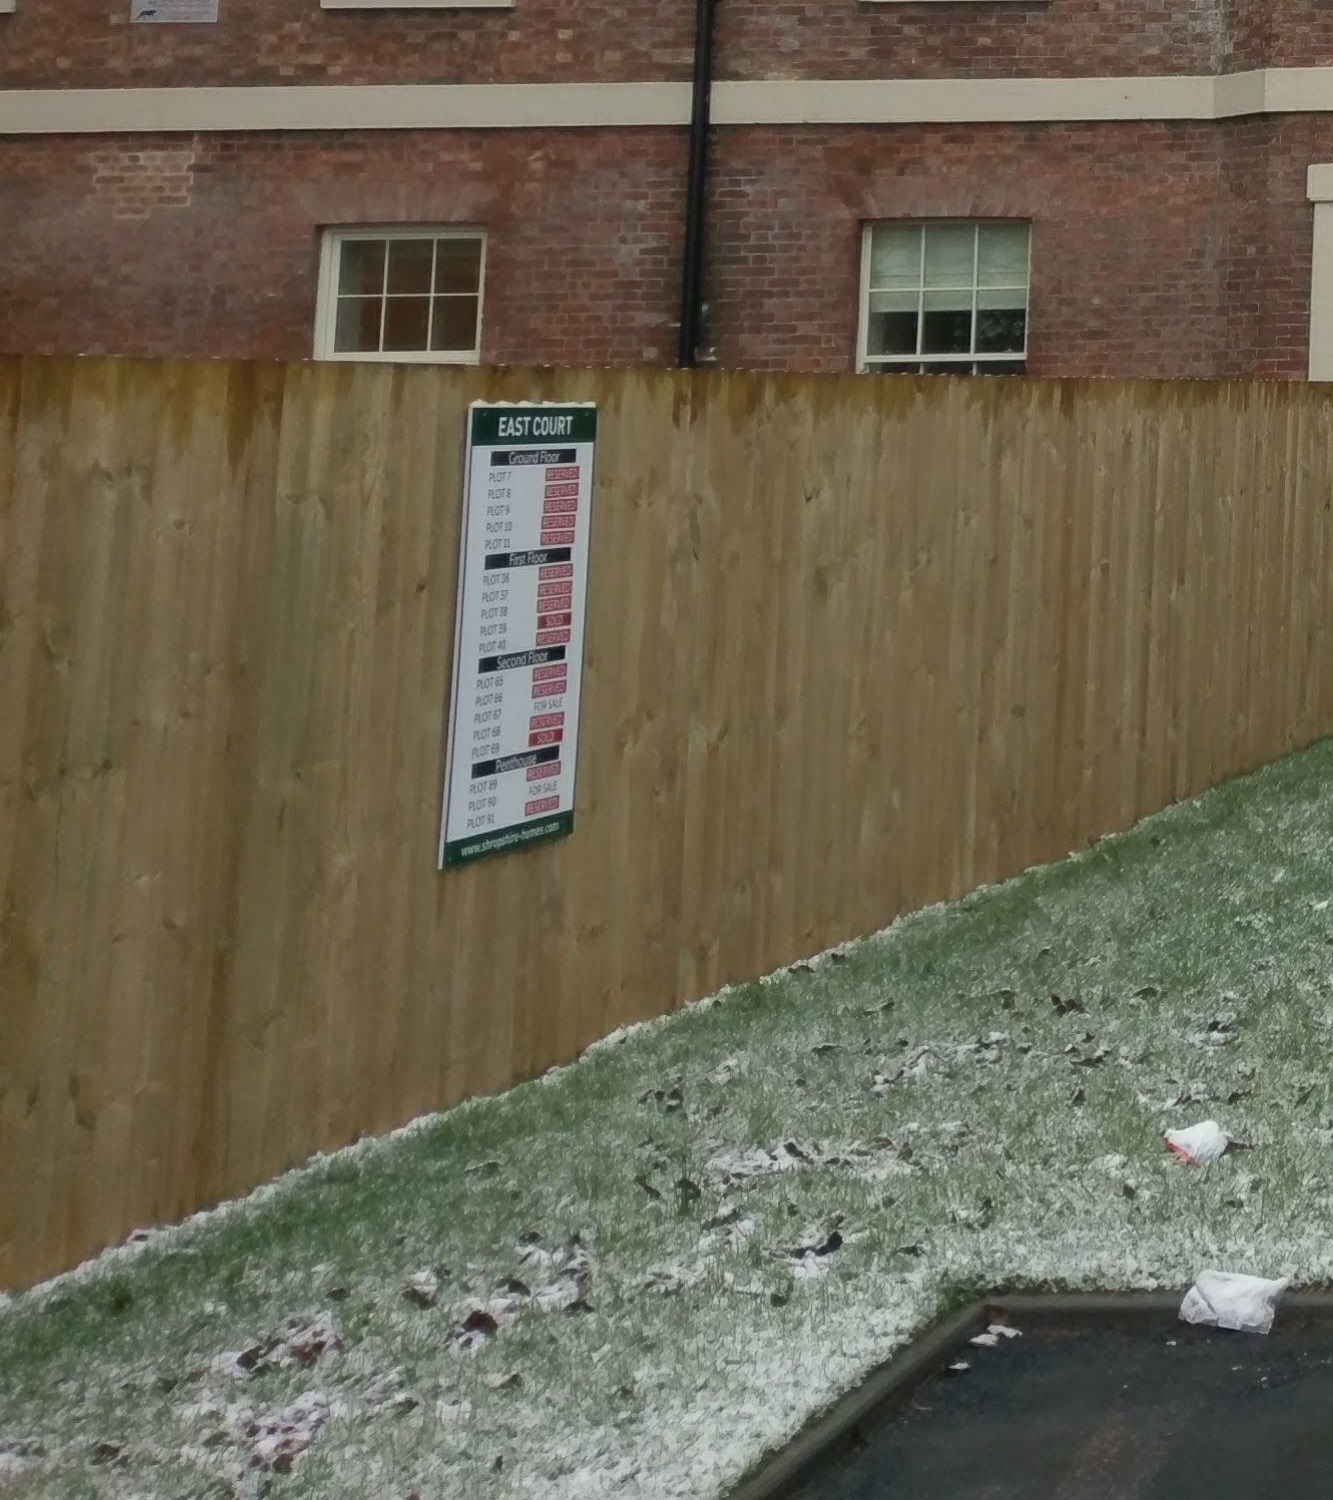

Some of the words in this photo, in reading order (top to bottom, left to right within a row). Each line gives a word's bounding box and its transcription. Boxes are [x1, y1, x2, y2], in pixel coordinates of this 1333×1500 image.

[498, 416, 532, 437] EAST
[532, 415, 574, 436] COURT
[508, 450, 540, 465] Ground
[540, 450, 561, 463] Floor
[488, 472, 506, 483] PLOT
[487, 488, 506, 500] PLOT
[486, 505, 505, 516] PLOT
[485, 522, 504, 533] PLOT
[484, 539, 503, 550] PLOT
[509, 552, 527, 567] First
[527, 551, 549, 564] Floor
[482, 574, 501, 586] PLOT
[481, 591, 501, 603] PLOT
[480, 607, 499, 620] PLOT
[480, 624, 498, 636] PLOT
[545, 614, 564, 627] SOLD
[479, 640, 497, 653] PLOT
[496, 654, 527, 670] Second
[527, 651, 549, 665] Floor
[476, 677, 495, 690] PLOT
[535, 665, 566, 680] RESERVED
[475, 693, 494, 707] PLOT
[534, 682, 565, 696] RESERVED
[474, 711, 493, 724] PLOT
[533, 700, 548, 712] FOR
[547, 697, 564, 710] SALE
[473, 728, 492, 741] PLOT
[532, 714, 564, 728] RESERVED
[471, 745, 491, 759] PLOT
[536, 730, 556, 744] SOLD
[495, 754, 538, 773] Penthouse
[469, 781, 489, 795] PLOT
[529, 764, 561, 779] RESERVED
[468, 799, 487, 812] PLOT
[528, 784, 543, 797] FOR
[542, 780, 558, 794] SALE
[466, 815, 486, 830] PLOT
[527, 797, 559, 814] RESERVED
[460, 821, 560, 858] www.shropshire-homes.com
